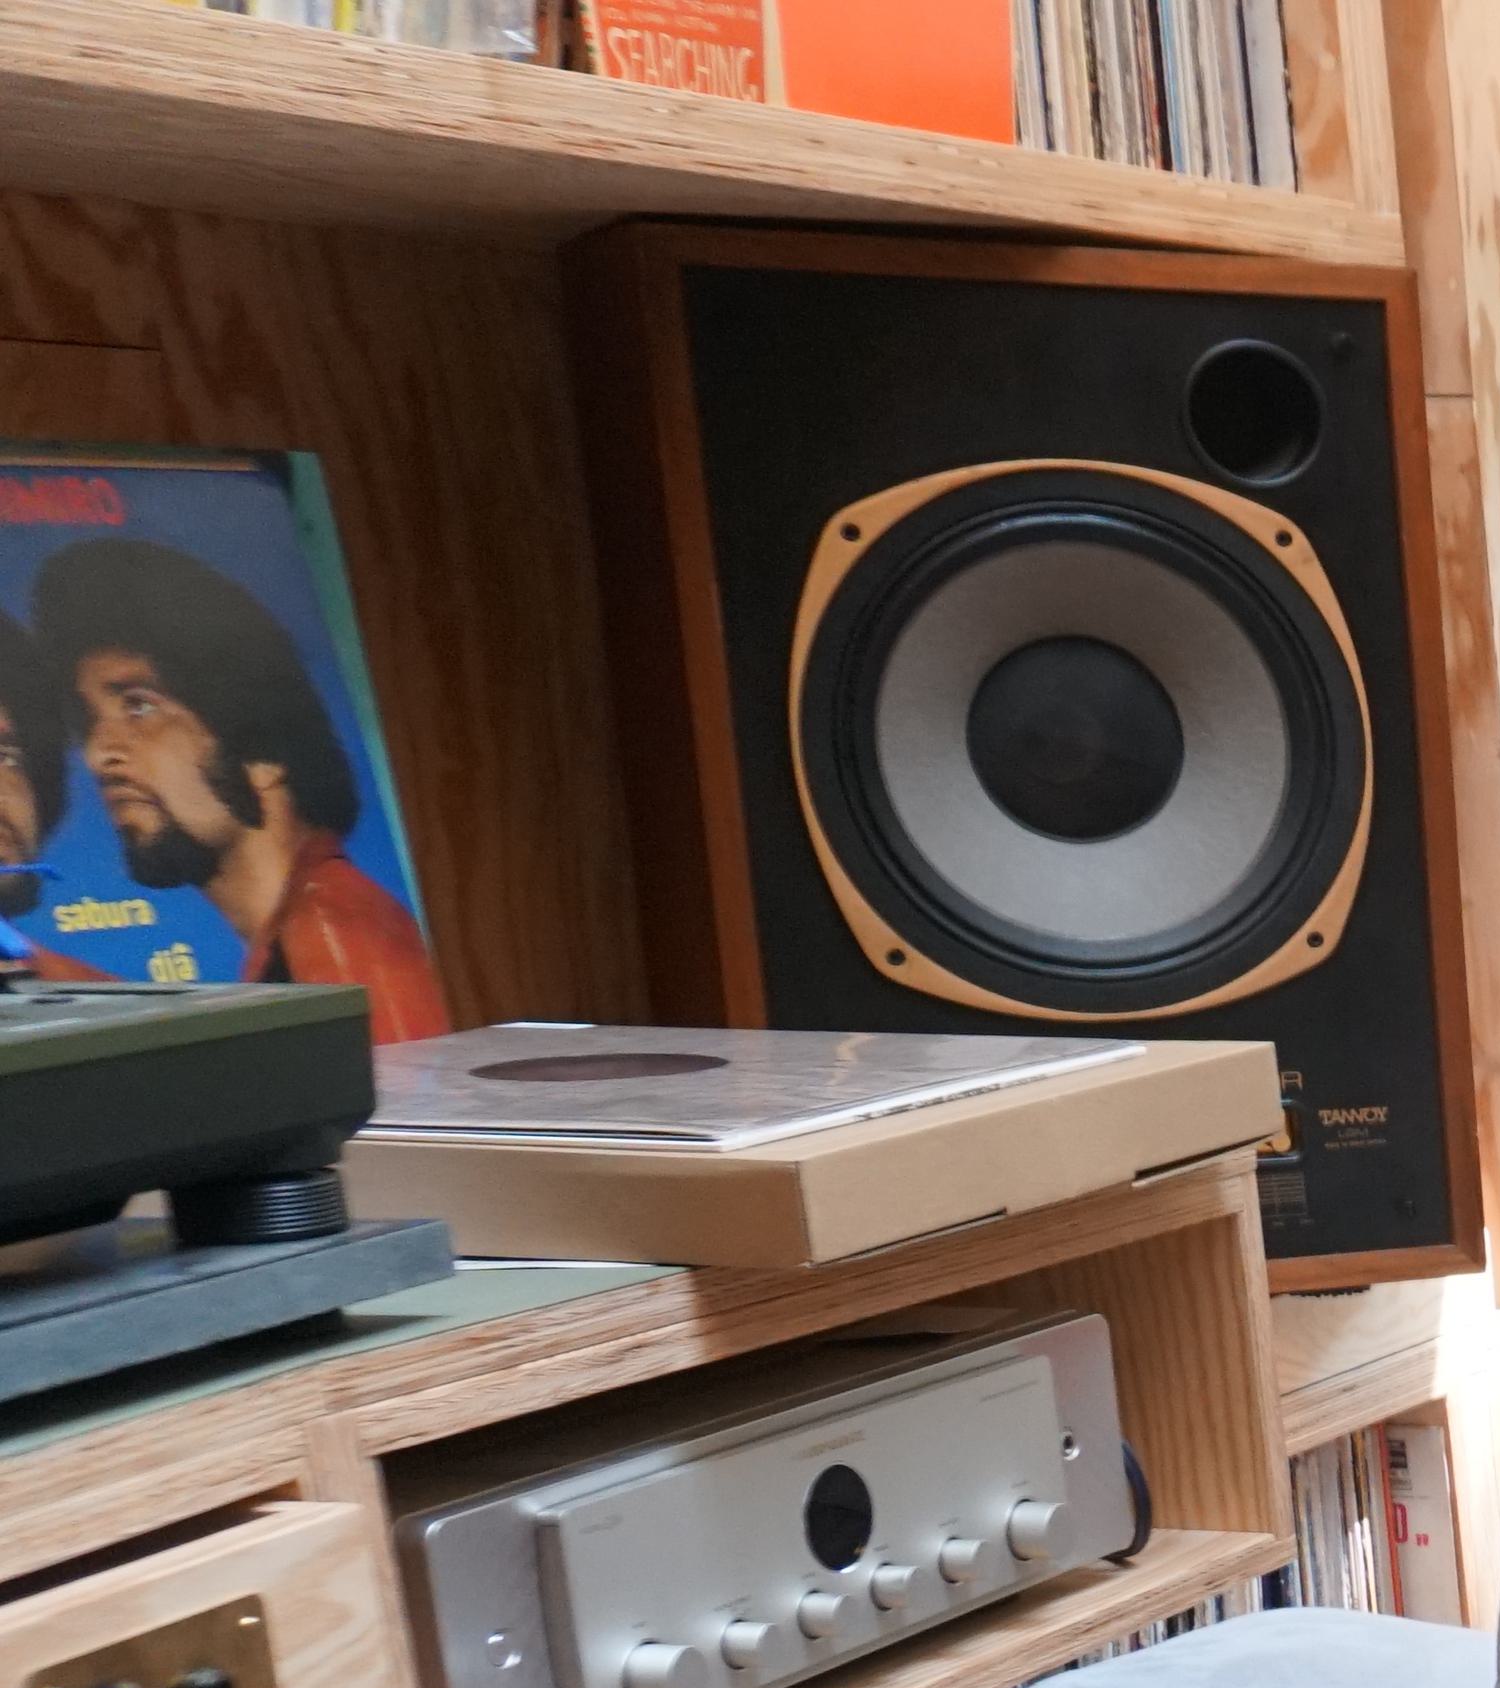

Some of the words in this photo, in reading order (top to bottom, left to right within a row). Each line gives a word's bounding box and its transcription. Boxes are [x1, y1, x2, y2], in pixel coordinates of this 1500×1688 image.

[606, 26, 760, 102] SEARCHING
[53, 895, 157, 933] sabura
[1318, 1105, 1388, 1127] TANNOY
